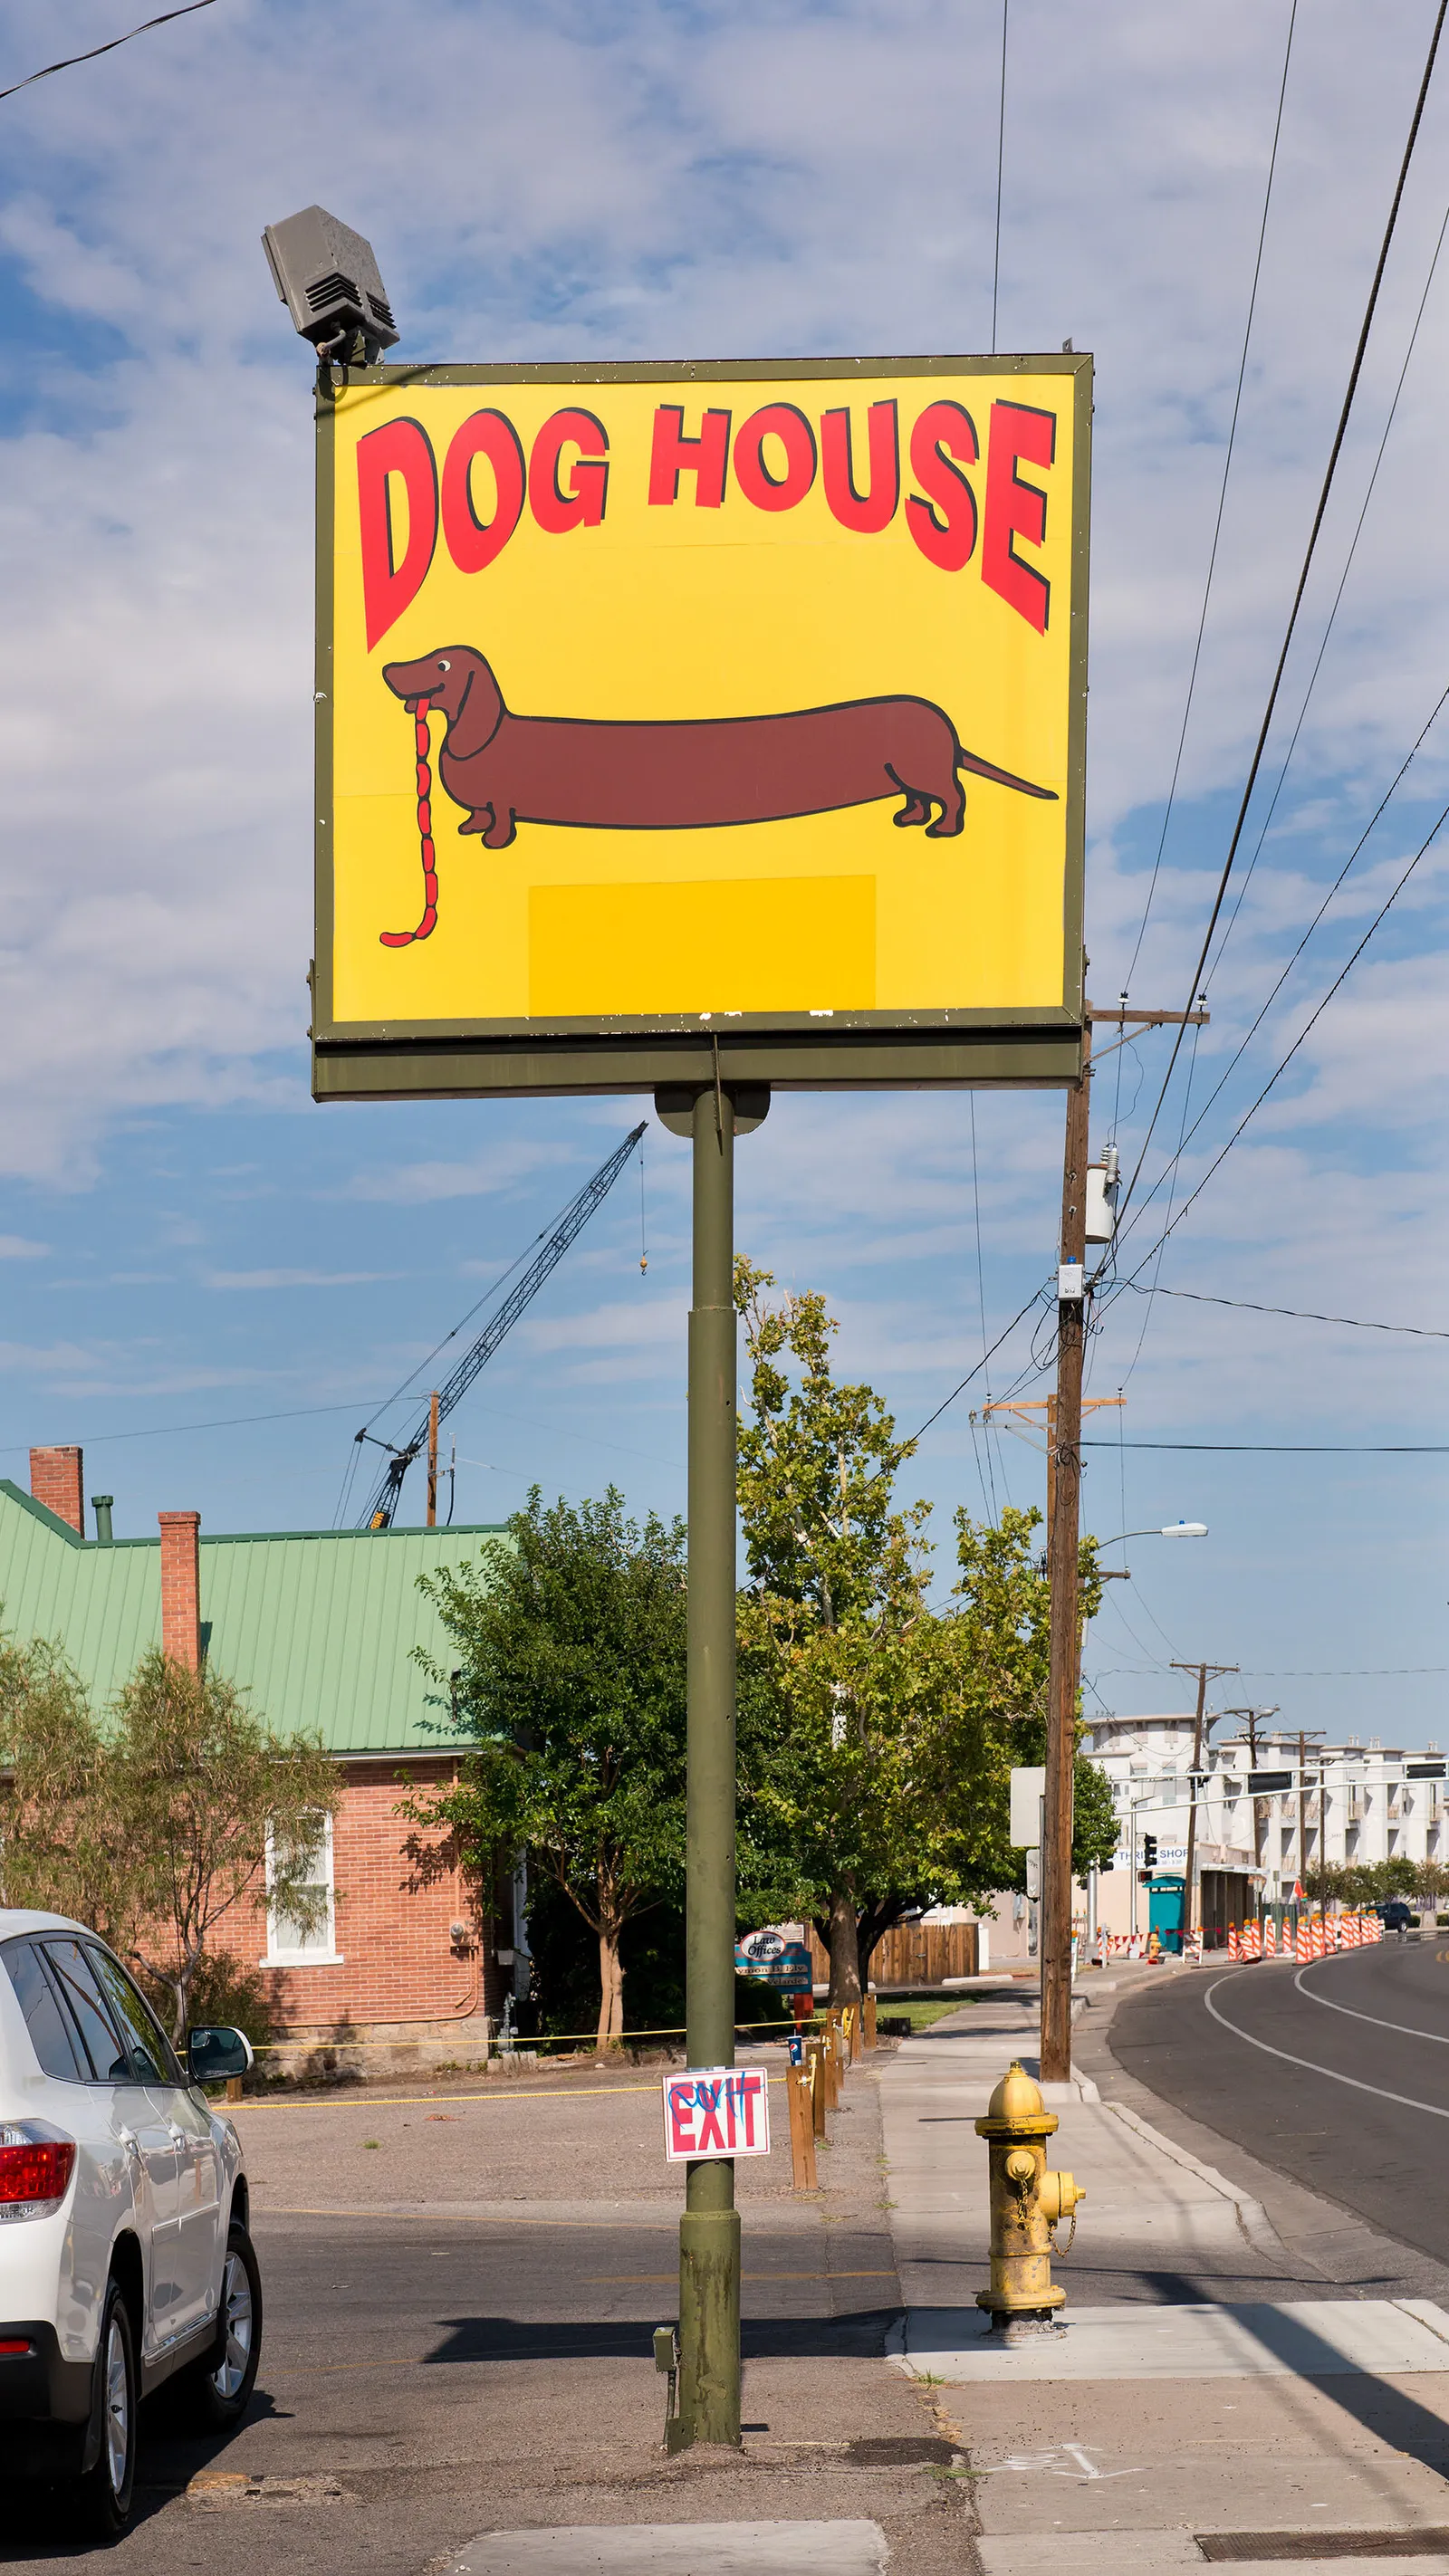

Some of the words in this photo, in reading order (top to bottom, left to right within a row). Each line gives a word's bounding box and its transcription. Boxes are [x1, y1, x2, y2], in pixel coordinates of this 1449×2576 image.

[356, 407, 610, 654] DOG
[648, 398, 1057, 637] HOUSE
[1118, 1849, 1156, 1861] THRI
[753, 1935, 775, 1945] Law
[748, 1944, 782, 1958] Offices
[785, 1964, 804, 1973] Ely
[670, 2076, 762, 2153] EXIT
